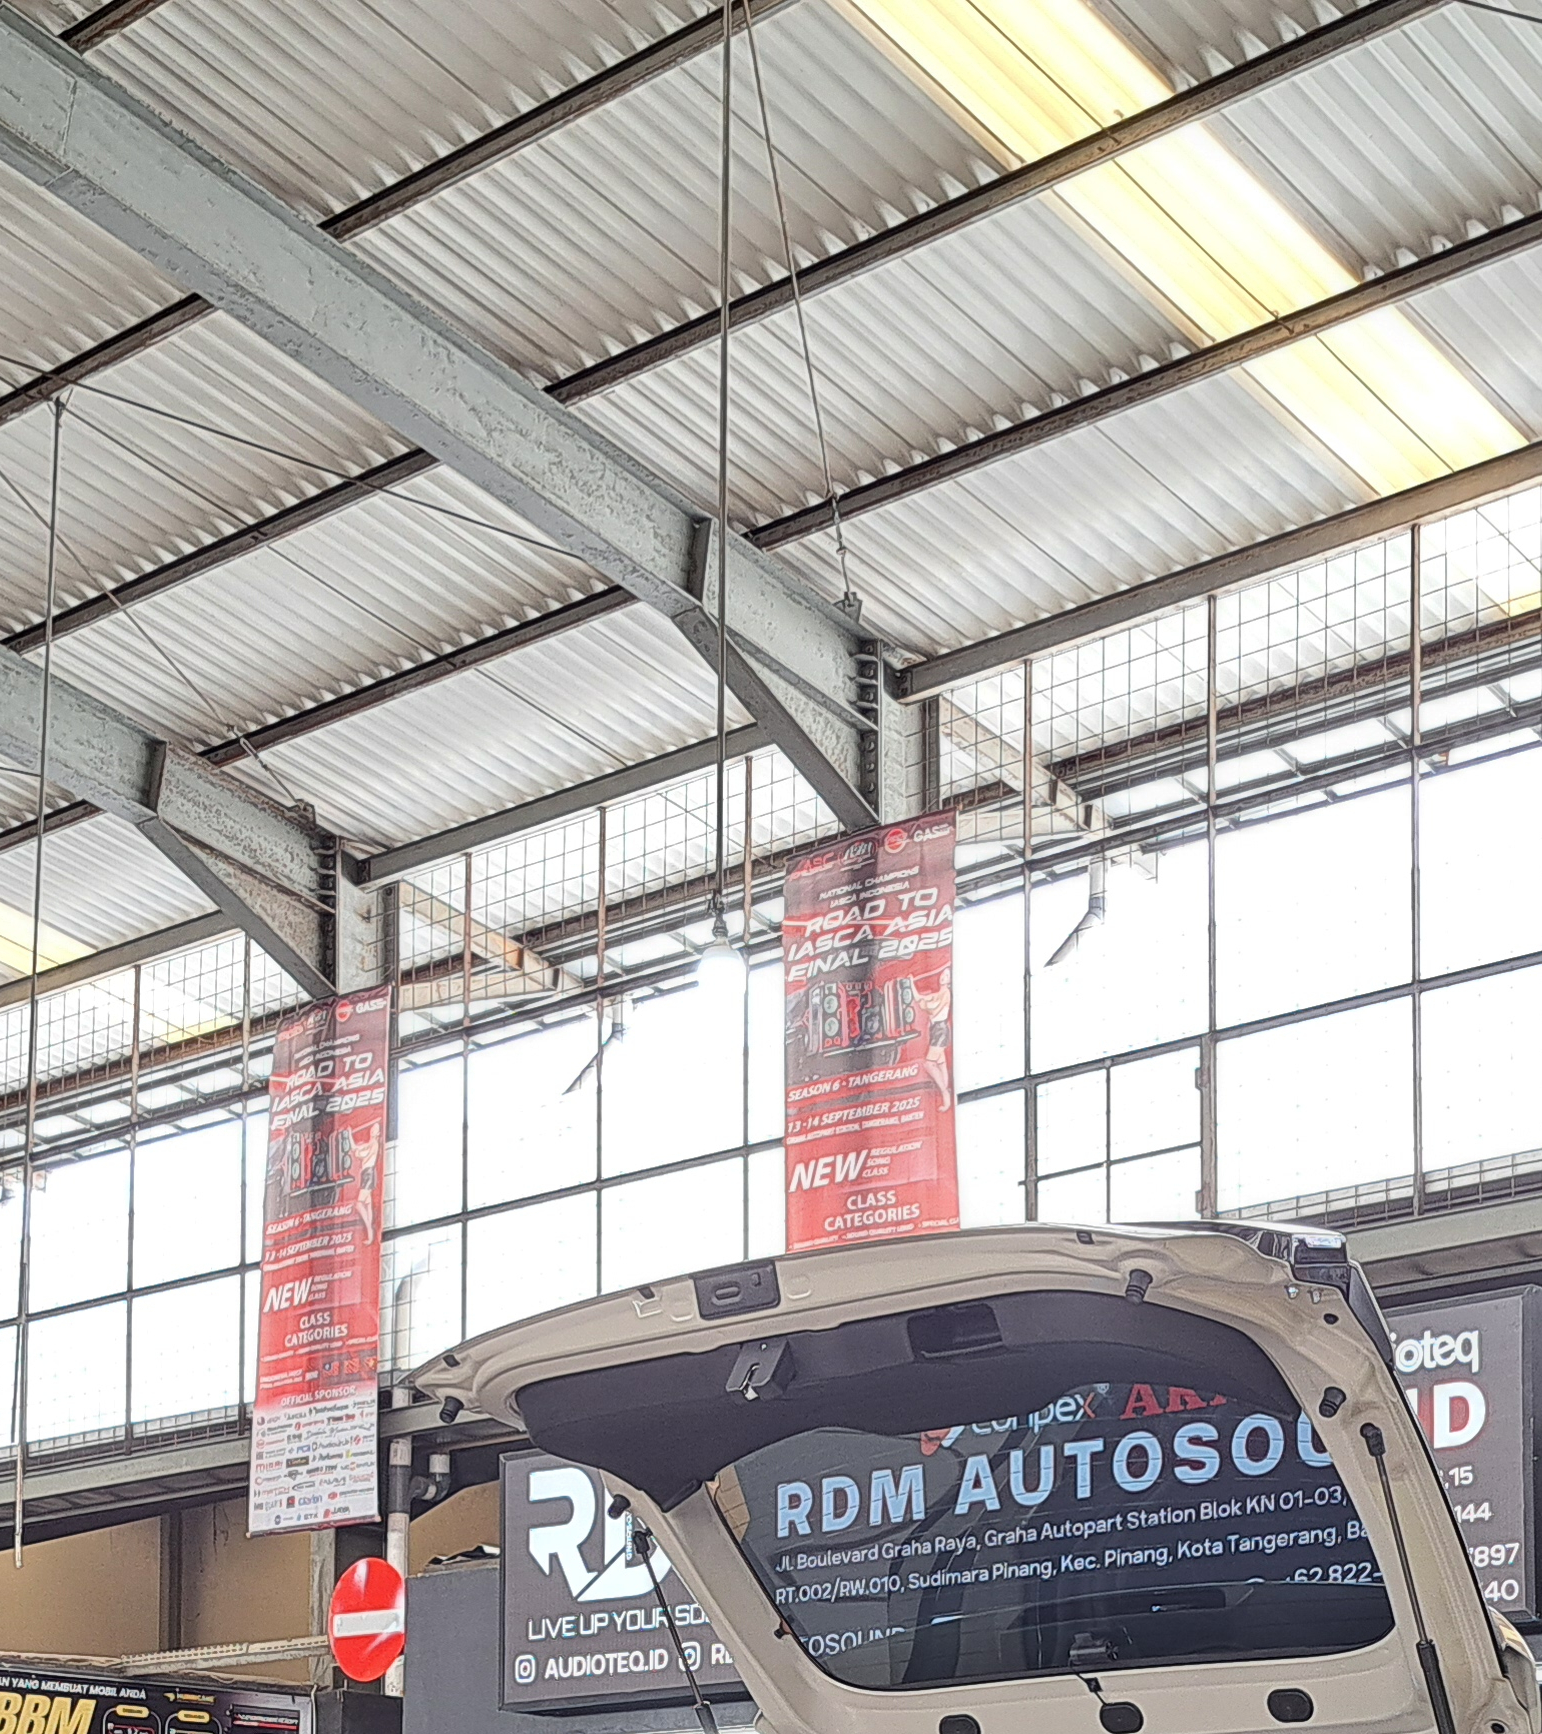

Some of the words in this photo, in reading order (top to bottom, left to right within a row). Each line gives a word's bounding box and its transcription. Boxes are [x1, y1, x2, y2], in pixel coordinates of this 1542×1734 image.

[805, 899, 885, 937] ROAD
[897, 887, 938, 911] TO
[787, 925, 874, 961] IASCA
[883, 904, 953, 937] ASIA
[787, 950, 869, 982] FINAL
[878, 927, 953, 960] 2025
[271, 1081, 323, 1112] IASCA
[331, 1069, 384, 1092] ASIA
[285, 1061, 332, 1091] ROAD
[343, 1053, 373, 1072] TO
[788, 1084, 830, 1102] SEASON
[832, 1079, 840, 1091] 6
[848, 1064, 919, 1088] TANGERANG
[325, 1087, 385, 1112] 2025
[820, 1102, 890, 1126] SEPTEMBER
[891, 1096, 921, 1112] 2025
[789, 1149, 868, 1193] NEW
[824, 1203, 920, 1232] CATEGORIES
[846, 1189, 896, 1210] CLASS
[263, 1276, 313, 1313] NEW
[284, 1325, 348, 1349] CATEGORIES
[299, 1312, 331, 1330] CLASS
[775, 1464, 926, 1538] RDM
[796, 1542, 878, 1569] Boulevard
[881, 1534, 931, 1560] Graha
[934, 1530, 981, 1558] Raya,
[984, 1525, 1037, 1549] Graha
[1040, 1511, 1123, 1544] Autopart
[1126, 1503, 1196, 1528] Station
[1200, 1498, 1243, 1521] Blok
[1247, 1494, 1276, 1515] KN
[908, 1564, 989, 1589] Sudimara
[992, 1556, 1058, 1582] Pinang,
[1060, 1548, 1103, 1572] Kec.
[1104, 1544, 1174, 1569] Pinang,
[1177, 1537, 1224, 1560] Kota
[1227, 1525, 1344, 1556] Tangerang,
[528, 1616, 577, 1641] LIVE
[579, 1611, 609, 1636] UP
[611, 1605, 672, 1632] YOUR
[544, 1649, 669, 1680] AUDIOTEQ.ID
[11, 1677, 39, 1690] YANG
[40, 1681, 88, 1695] MEMBUAT
[88, 1685, 117, 1697] MOBIL
[119, 1688, 147, 1700] ANDA
